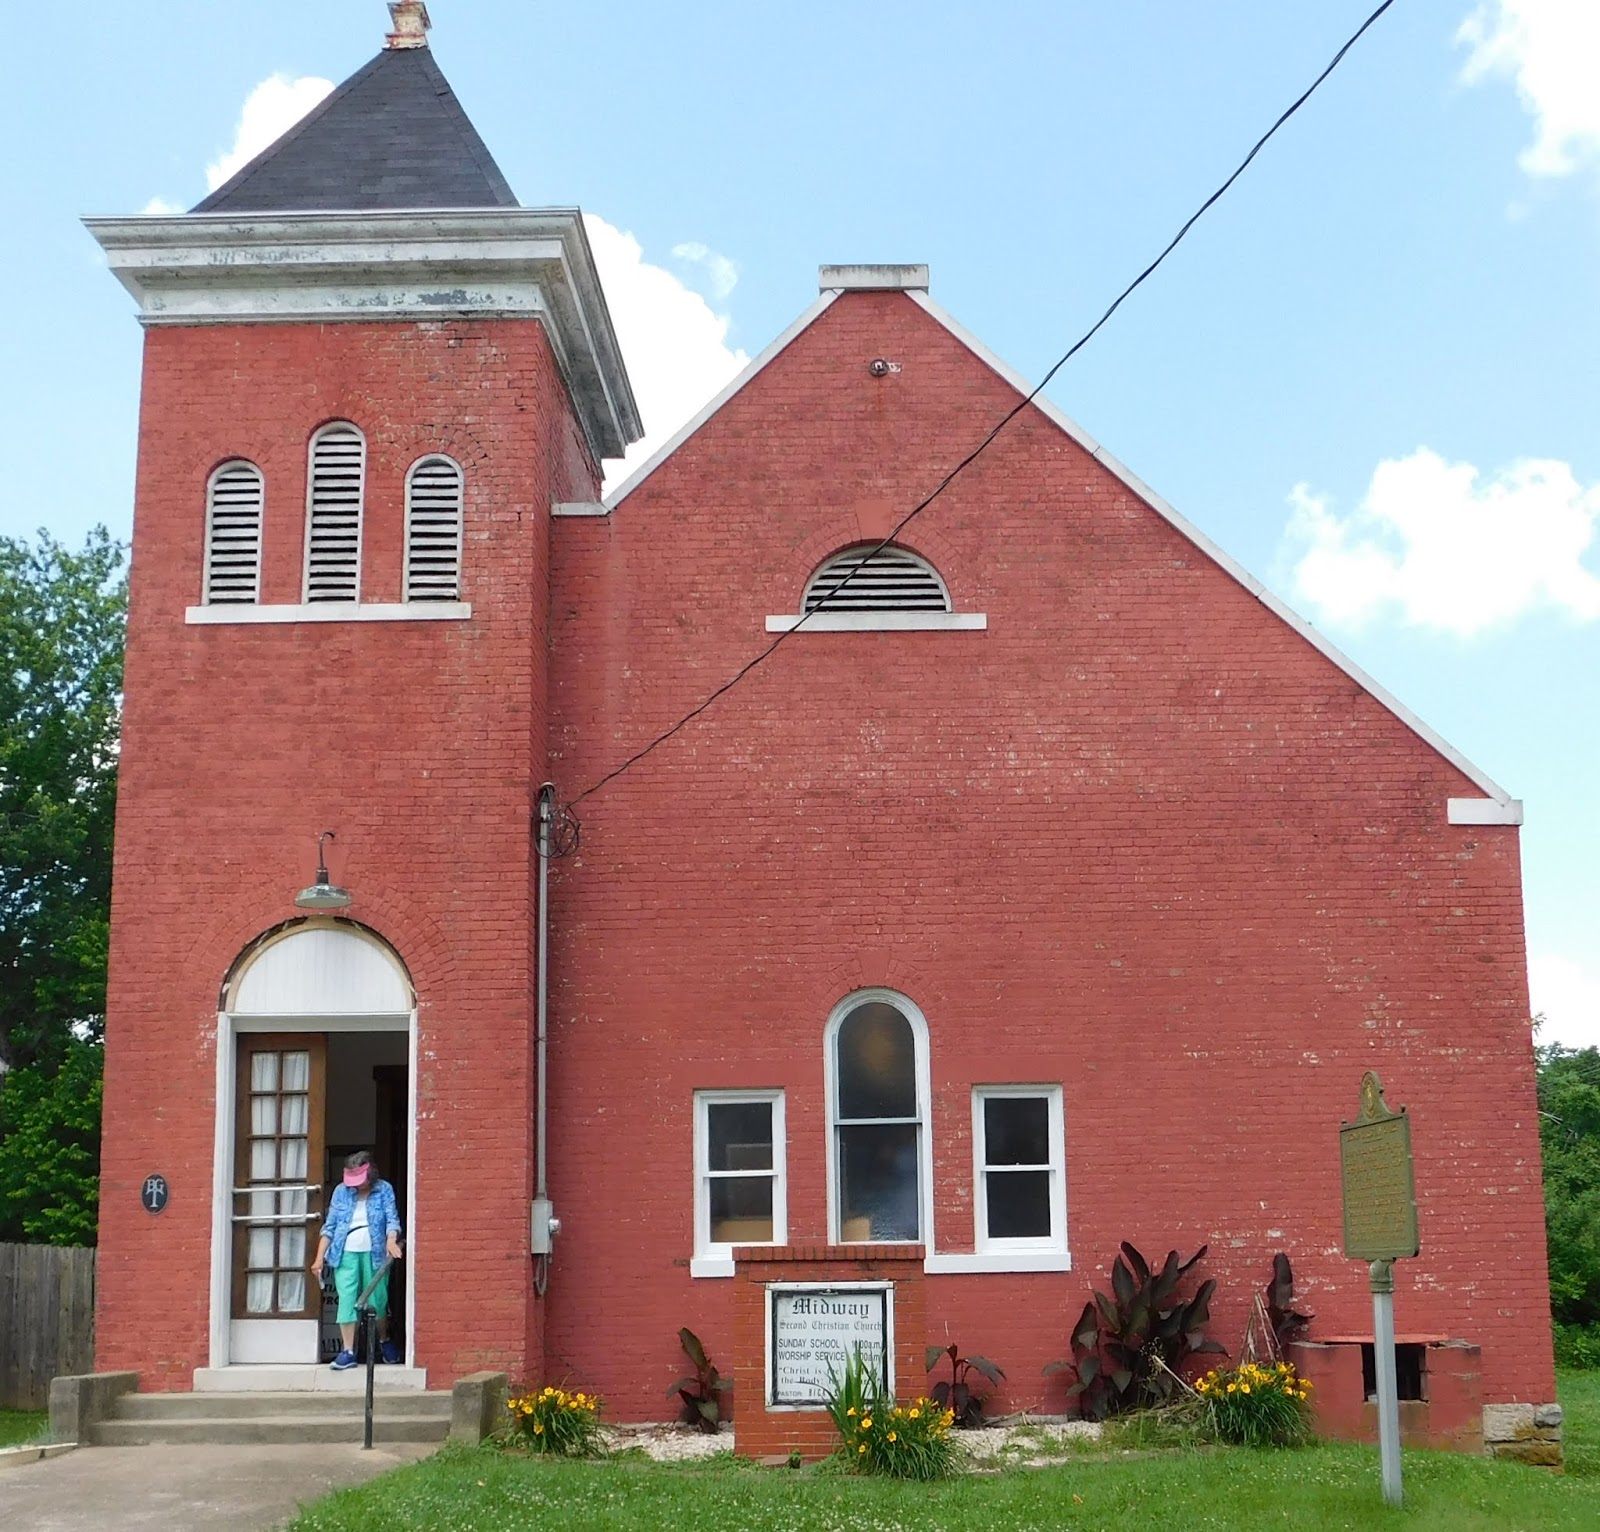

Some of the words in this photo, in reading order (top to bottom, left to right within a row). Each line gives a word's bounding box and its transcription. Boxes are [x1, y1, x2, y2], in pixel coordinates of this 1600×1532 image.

[792, 1298, 869, 1319] Midway
[779, 1320, 808, 1330] Second
[812, 1320, 850, 1331] Christian
[854, 1320, 882, 1331] Church
[778, 1338, 807, 1349] SUNDAY
[810, 1339, 840, 1349] SCHOOL
[778, 1351, 811, 1361] WORSHIP
[815, 1351, 845, 1361] SERVICE
[815, 1367, 822, 1375] is
[781, 1376, 794, 1384] the
